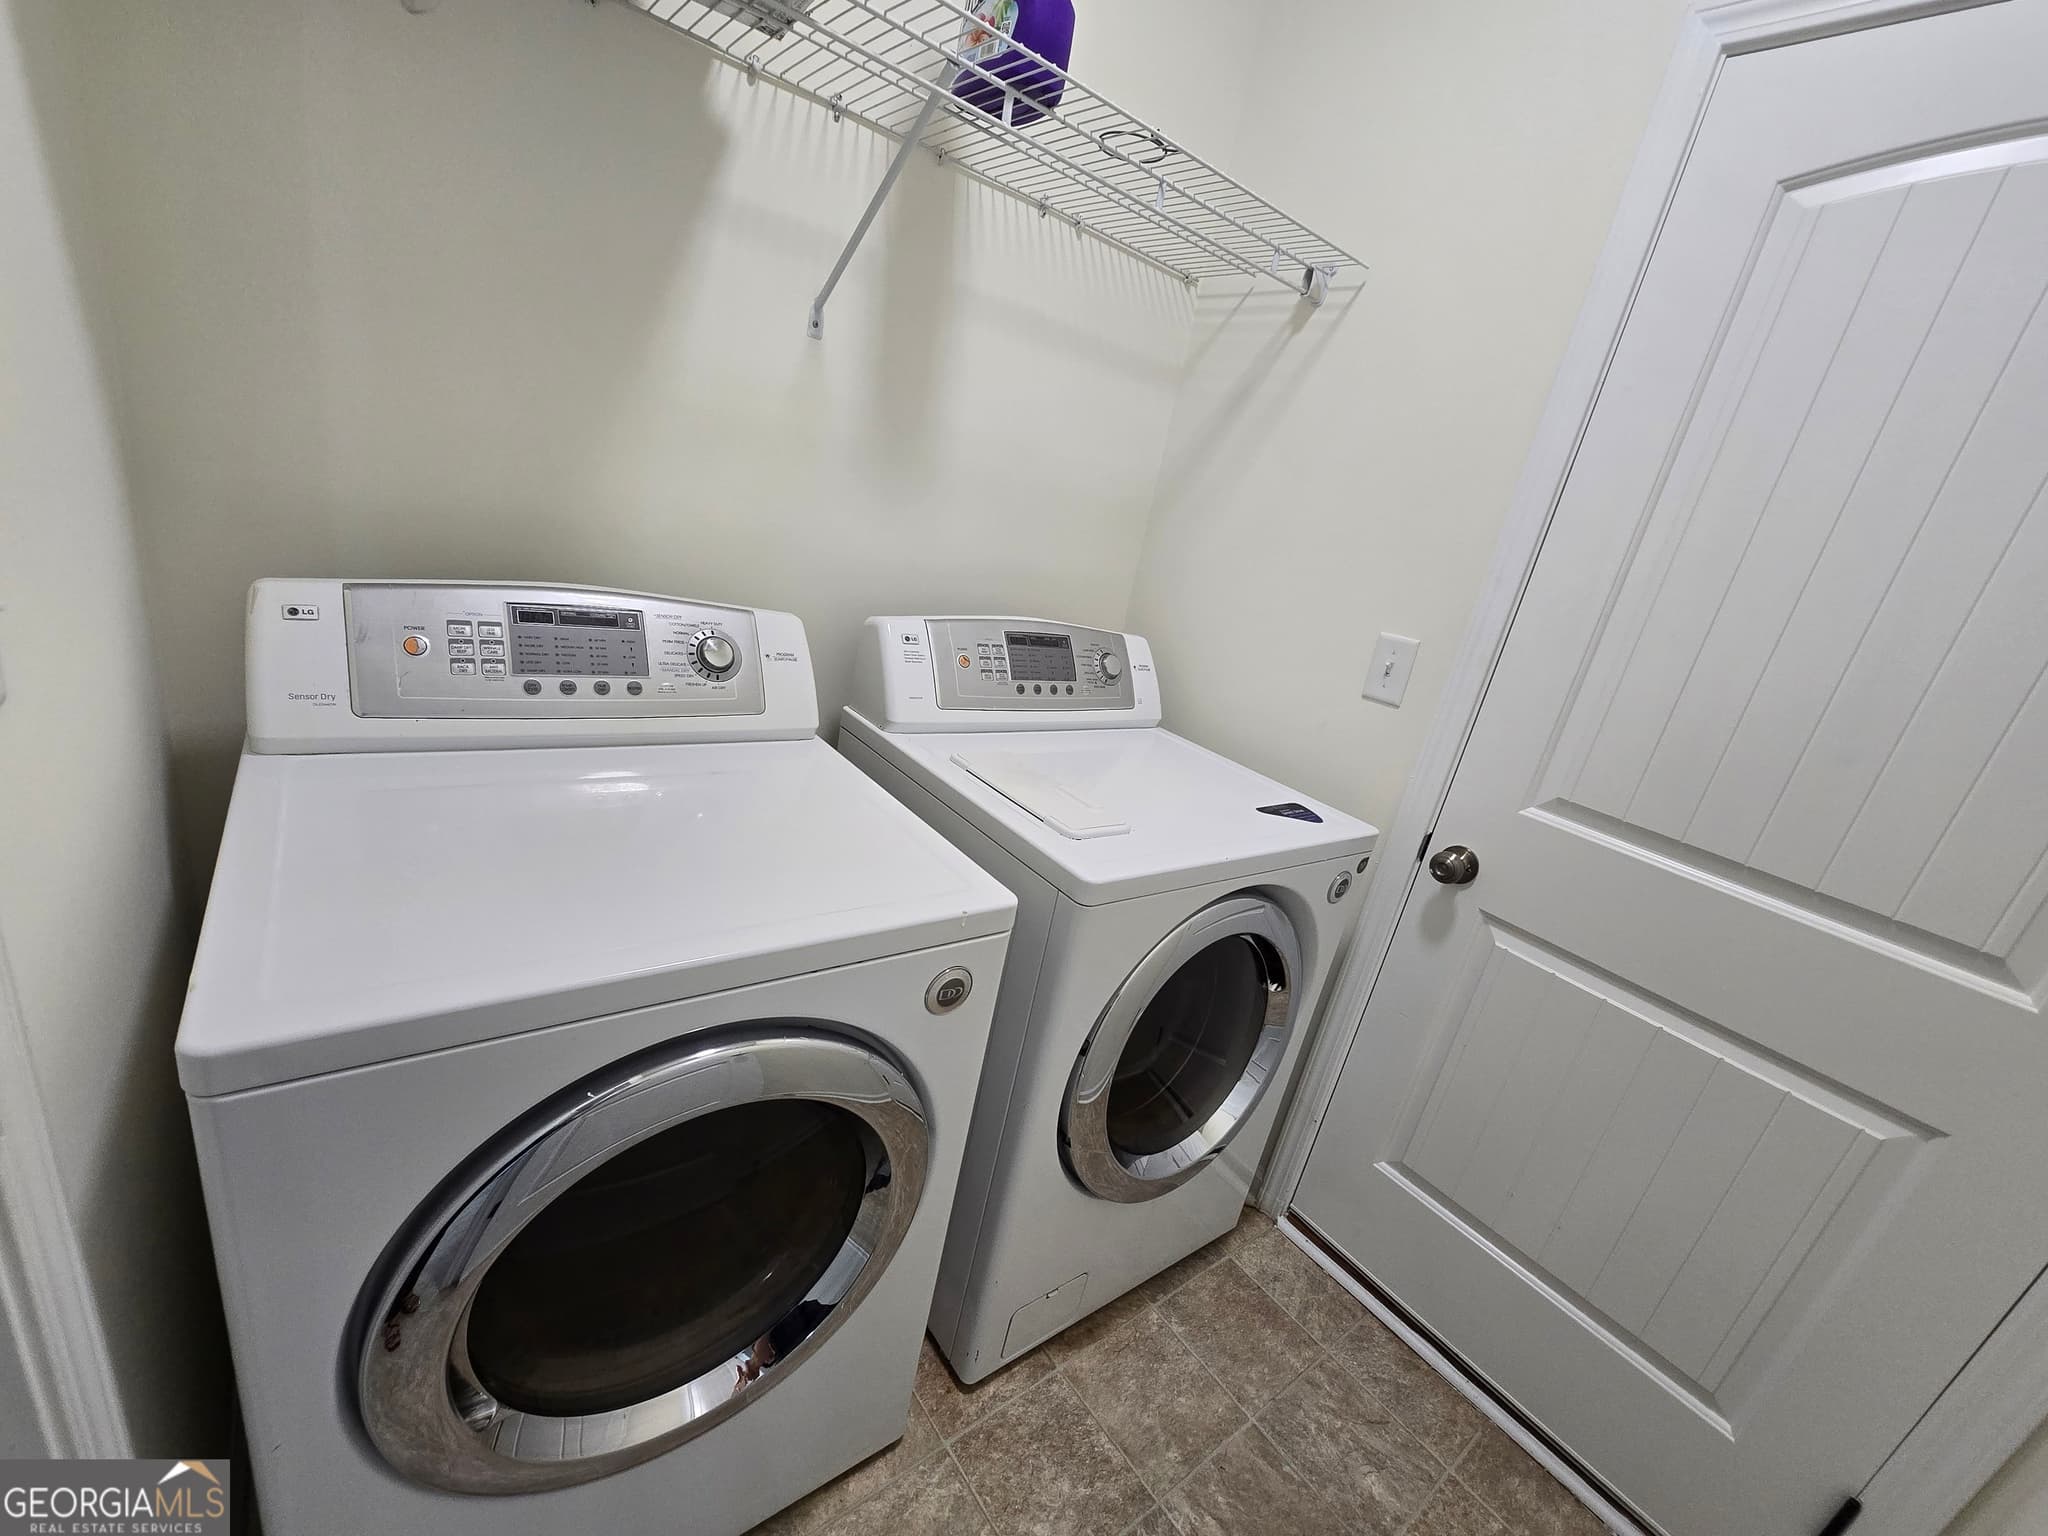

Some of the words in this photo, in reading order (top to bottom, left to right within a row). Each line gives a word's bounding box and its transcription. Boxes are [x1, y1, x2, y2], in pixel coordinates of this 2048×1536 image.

[301, 608, 315, 616] LG
[288, 692, 319, 701] Sensor
[320, 692, 336, 702] Dry
